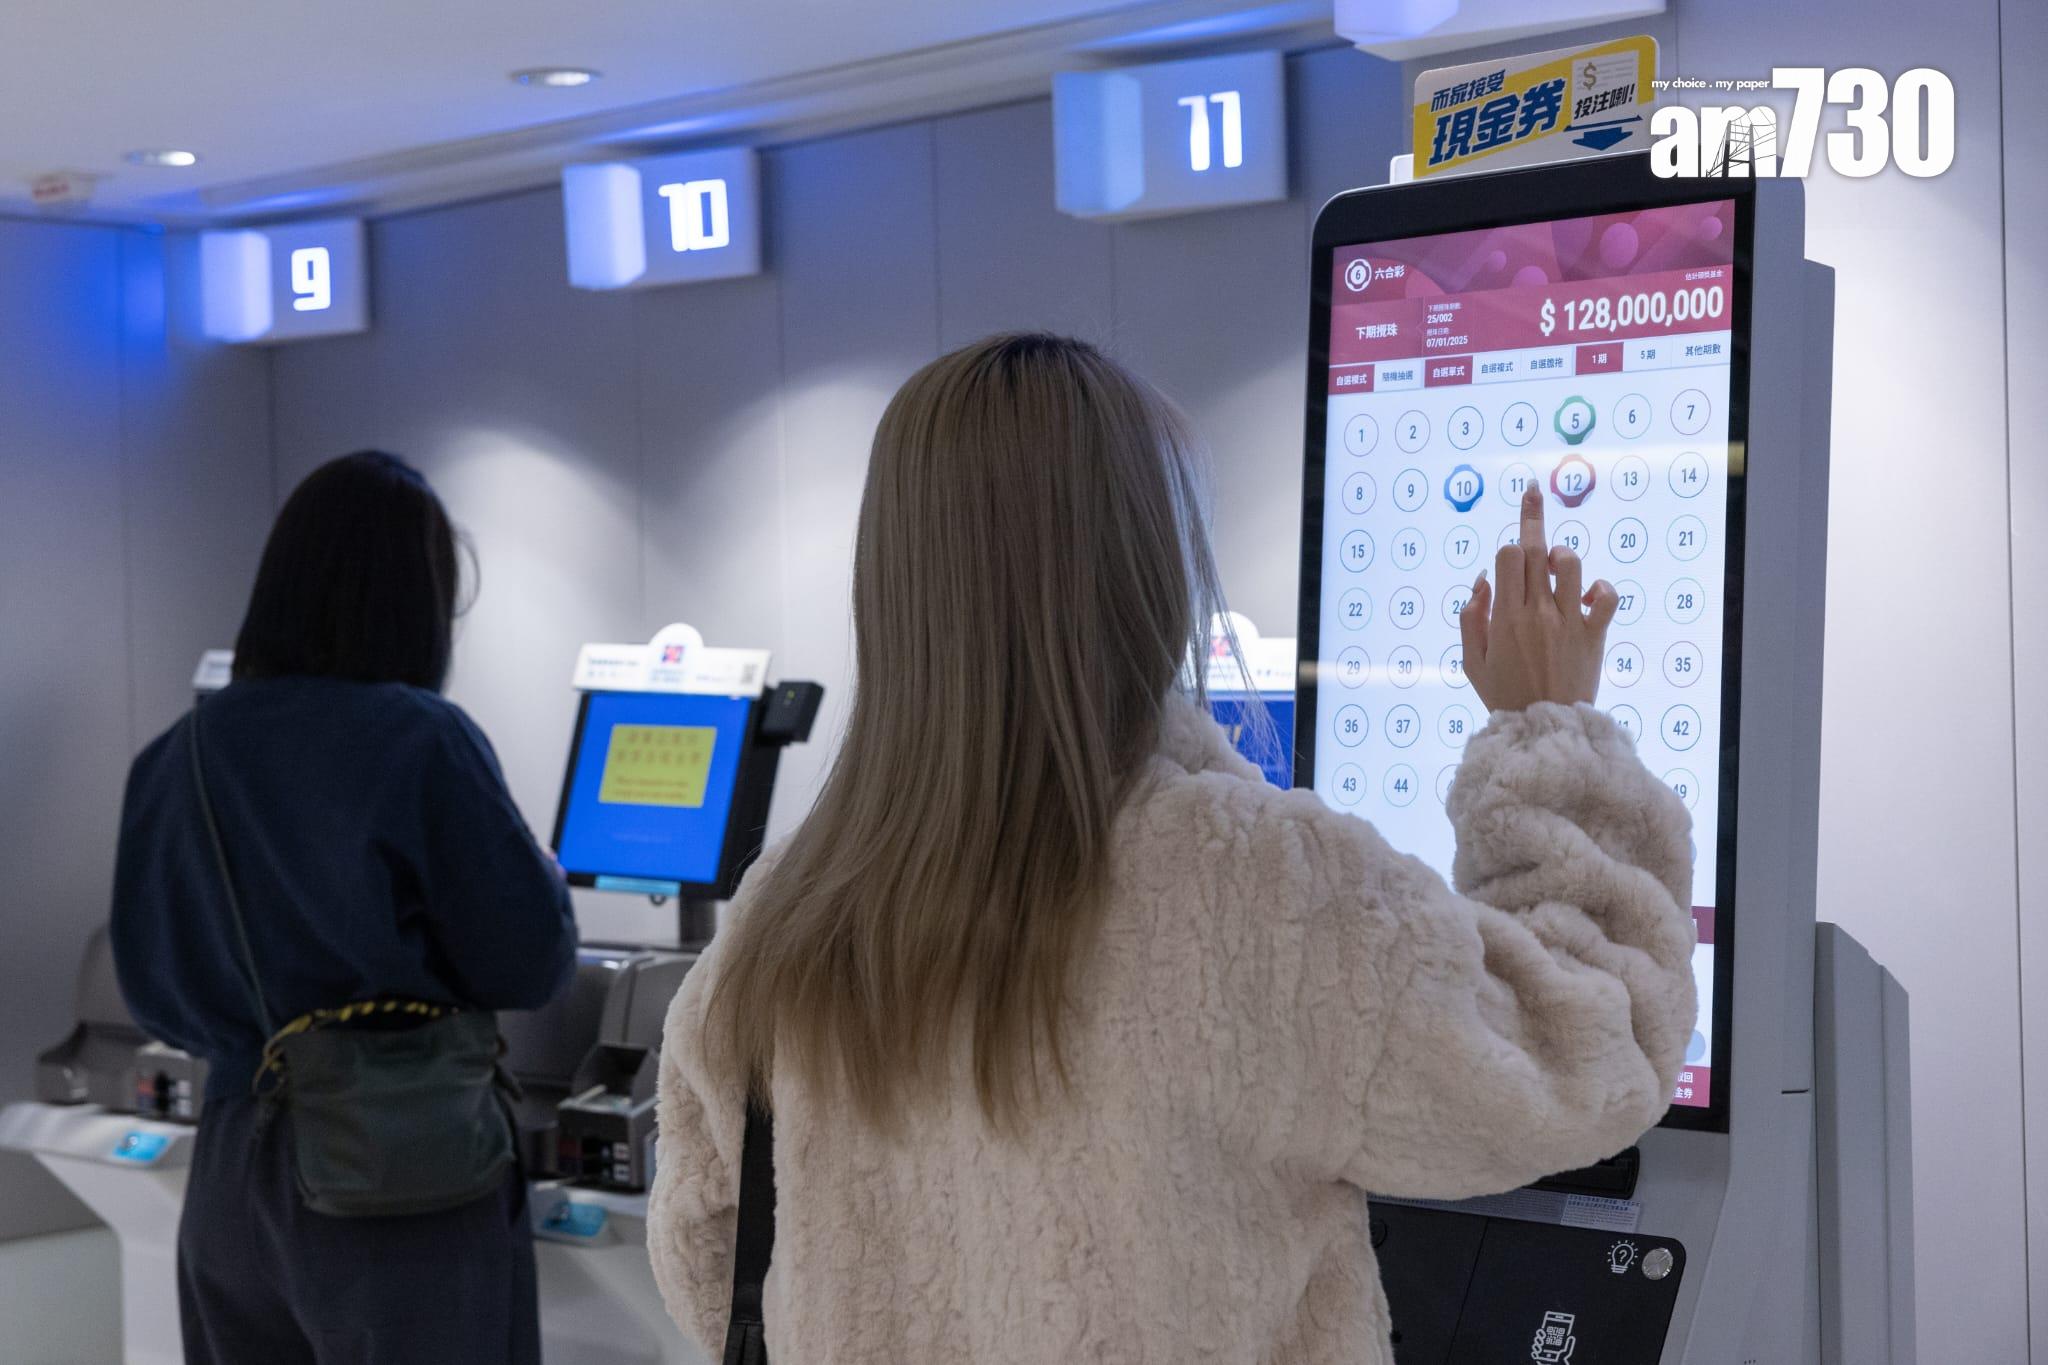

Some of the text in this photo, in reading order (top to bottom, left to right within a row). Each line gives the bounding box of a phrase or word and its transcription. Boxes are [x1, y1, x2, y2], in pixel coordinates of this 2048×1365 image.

[1431, 69, 1506, 112] 而家接受
[1177, 90, 1243, 172] 11
[658, 178, 730, 252] 10
[291, 247, 331, 311] 9
[1374, 265, 1405, 281] 六合彩
[1427, 312, 1454, 325] 25/002
[1540, 286, 1724, 337] $ 128,000,000
[1426, 335, 1469, 348] 07/01/2025
[1358, 405, 1695, 443] 1 2 3 4 5 6 7
[1356, 467, 1697, 501] 8 9 10 11 12 13 14
[1351, 530, 1694, 559] 15 16 17 19 20 21
[1348, 602, 1363, 617] 22
[1400, 601, 1414, 616] 23
[1618, 595, 1634, 611] 27
[1677, 593, 1693, 610] 28
[1347, 660, 1361, 675] 29
[1398, 659, 1412, 675] 30
[1616, 657, 1632, 673] 34
[1675, 657, 1692, 673] 35
[1344, 719, 1689, 736] 36 37 38 42
[1342, 777, 1357, 792] 43
[1394, 778, 1409, 793] 44
